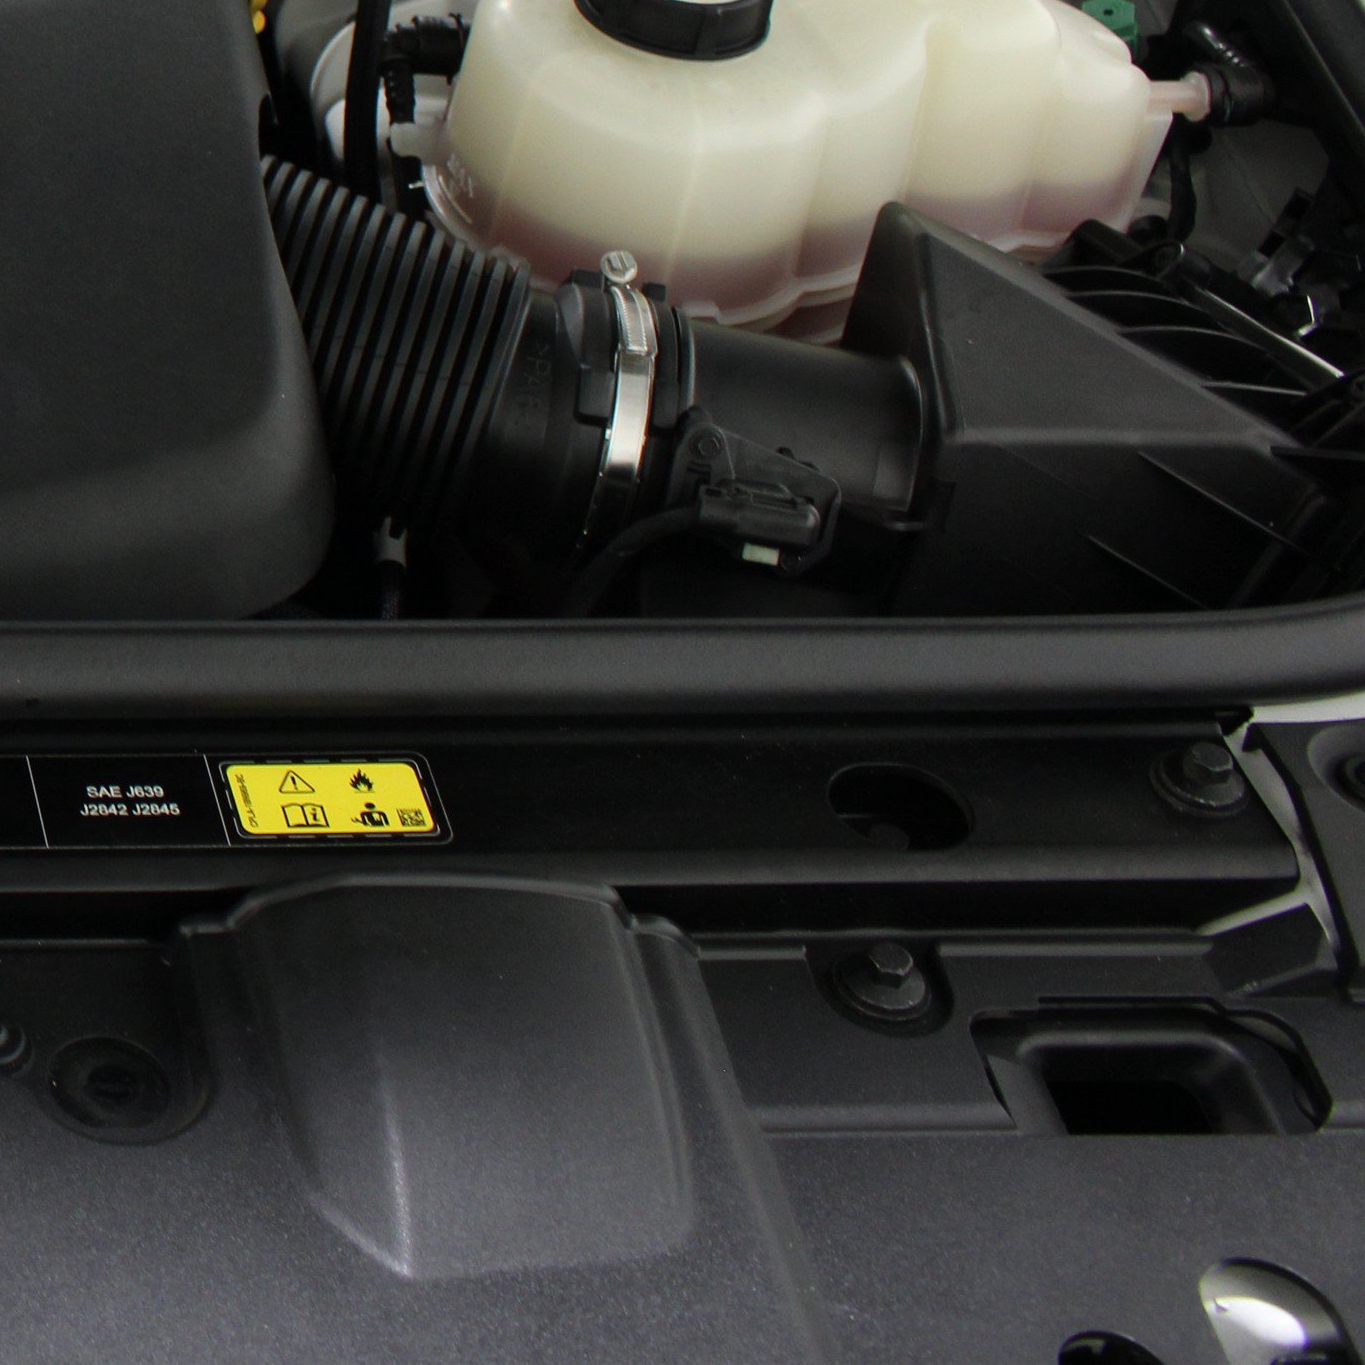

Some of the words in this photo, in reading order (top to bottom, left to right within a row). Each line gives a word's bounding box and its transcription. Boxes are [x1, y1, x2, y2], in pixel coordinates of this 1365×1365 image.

[86, 784, 122, 798] SAE
[125, 784, 165, 798] J639
[80, 802, 129, 816] J2842
[132, 802, 181, 816] J2845
